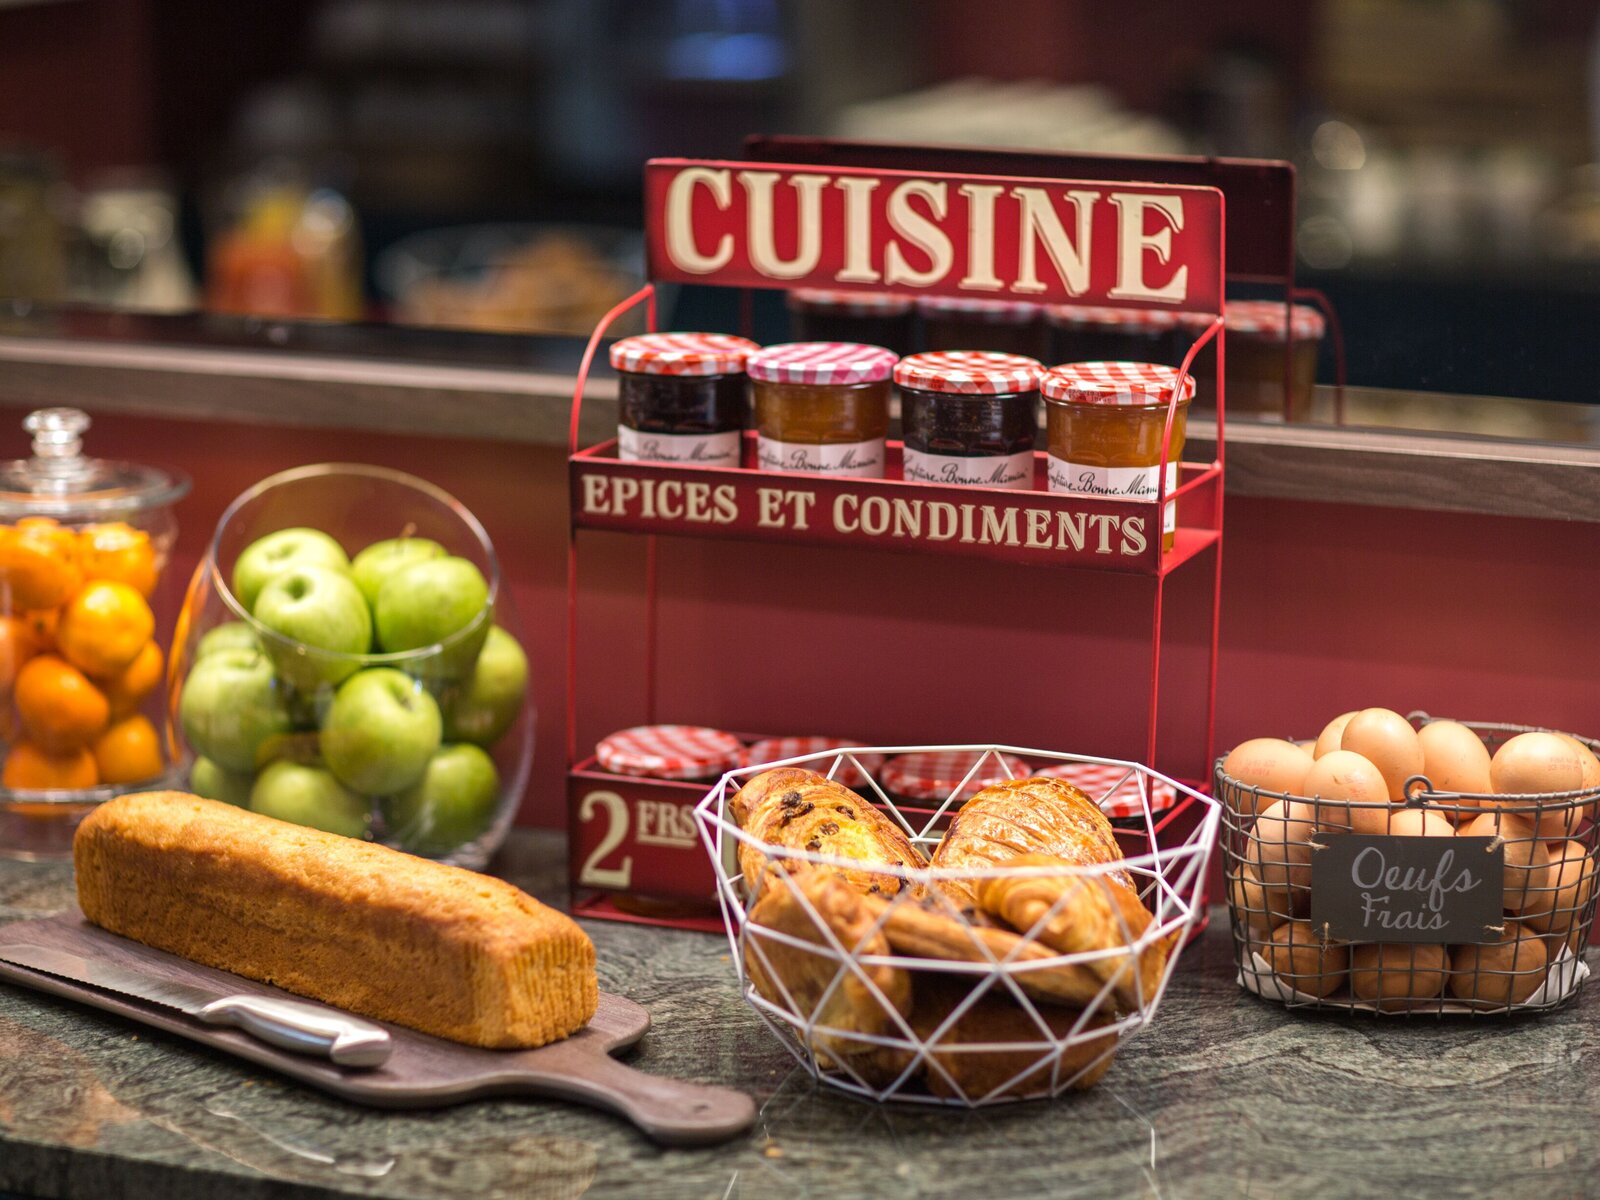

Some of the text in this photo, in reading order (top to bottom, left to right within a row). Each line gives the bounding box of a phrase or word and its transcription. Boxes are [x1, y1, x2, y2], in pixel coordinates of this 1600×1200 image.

[667, 167, 1188, 303] CUISINE
[940, 462, 982, 485] Bonne
[1078, 471, 1120, 495] Bonne
[581, 473, 1148, 556] EPICES ET CONDIMENTS
[579, 790, 633, 888] 2
[637, 800, 699, 838] FRS
[1351, 846, 1483, 913] Oeufs
[1360, 892, 1450, 930] Frais
